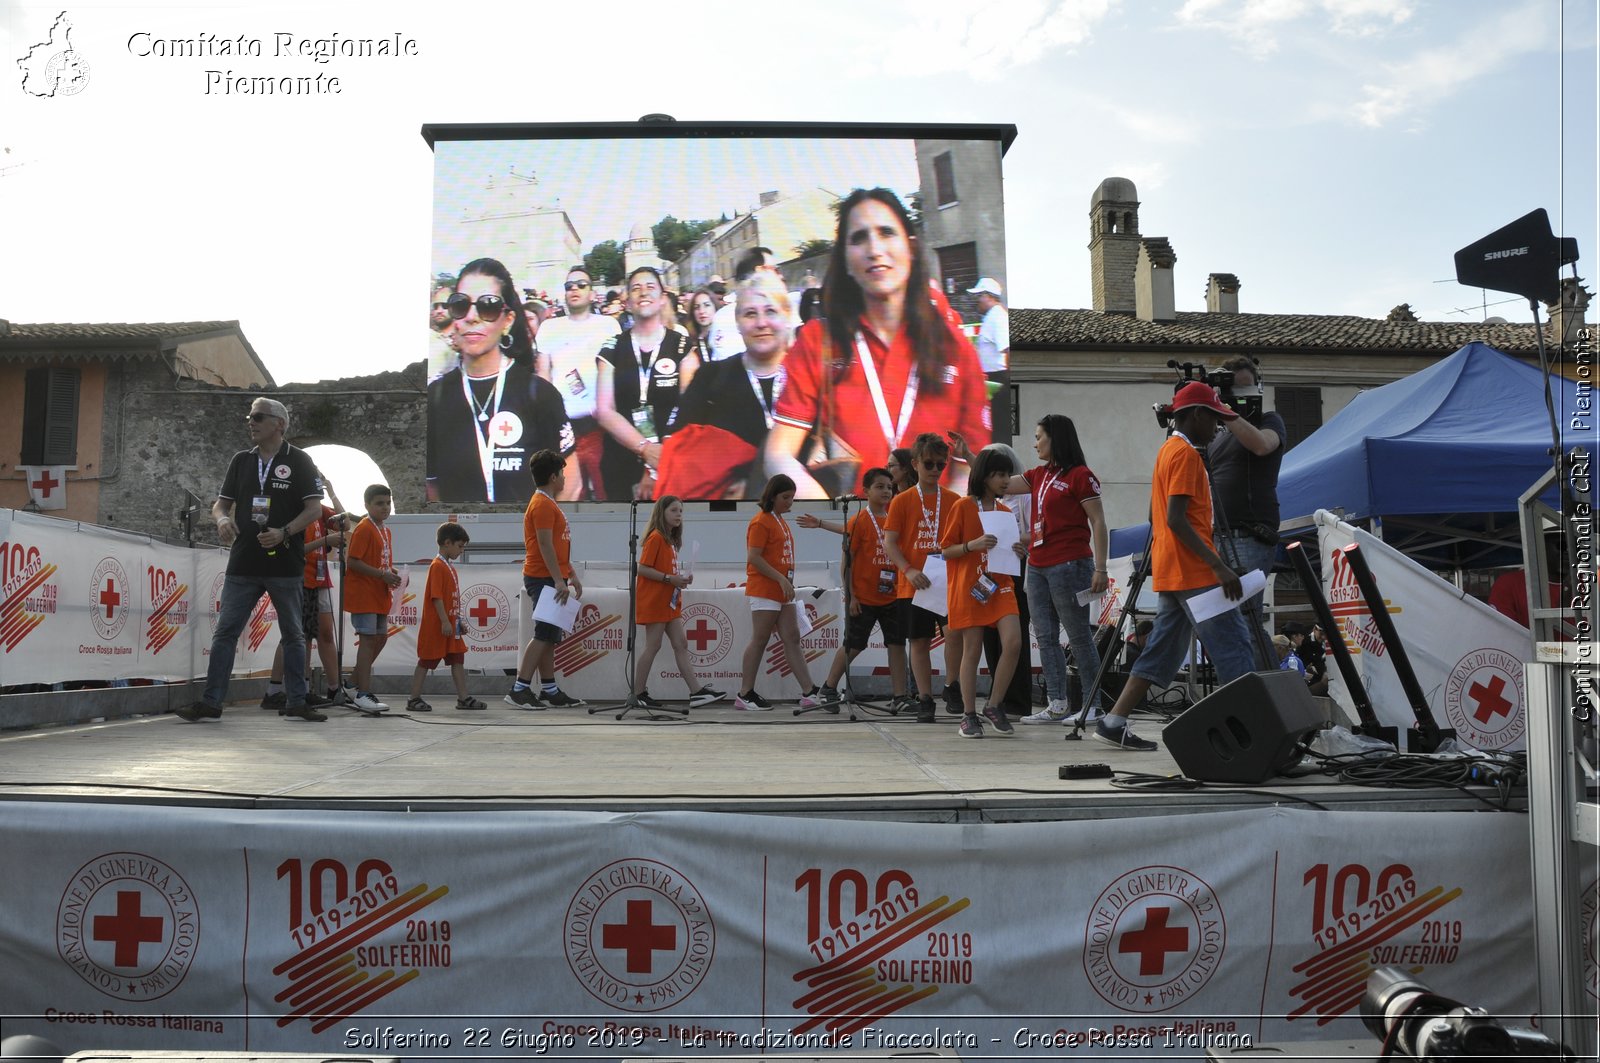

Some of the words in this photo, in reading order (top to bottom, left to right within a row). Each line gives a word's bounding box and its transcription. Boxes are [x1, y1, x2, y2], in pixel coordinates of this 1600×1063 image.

[1484, 246, 1529, 260] SHURE
[272, 482, 290, 490] STAFF
[3, 557, 42, 599] 1919-2019
[148, 565, 176, 601] 100
[42, 583, 57, 598] 2019
[1330, 586, 1359, 602] 1919-20
[25, 597, 57, 613] SOLFERINO
[401, 607, 417, 616] 2019
[604, 629, 623, 639] 2019
[689, 606, 720, 619] GINEVRA
[719, 626, 731, 654] AGOSTO
[821, 628, 839, 638] 2019
[1345, 617, 1386, 657] SOLFERINO
[79, 645, 96, 654] Croce
[96, 645, 113, 654] Rossa
[471, 645, 492, 653] Rossa
[583, 639, 623, 650] SOLFERINO
[800, 639, 839, 649] SOLFERINO
[1449, 658, 1476, 734] CONVENZIONE
[1476, 653, 1486, 666] DI
[80, 869, 100, 892] DI
[99, 858, 170, 891] GINEVRA
[609, 866, 683, 900] GINEVRA
[168, 885, 188, 907] 22
[277, 858, 393, 932] 100
[588, 878, 610, 901] DI
[1107, 887, 1128, 910] DI
[1127, 873, 1200, 904] GINEVRA
[1303, 863, 1413, 935] 100
[291, 876, 398, 950] 1919-2019
[681, 897, 700, 915] 22
[795, 868, 914, 945] 100
[1195, 897, 1213, 916] 22
[1314, 879, 1416, 950] 1919-2019
[406, 920, 451, 942] 2019
[810, 887, 919, 963] 1919-2019
[1421, 920, 1462, 944] 2019
[63, 887, 121, 993] CONVENZIONE
[165, 910, 194, 978] AGOSTO
[570, 897, 628, 1003] CONVENZIONE
[679, 919, 709, 985] AGOSTO
[927, 932, 972, 957] 2019
[1189, 919, 1220, 983] AGOSTO
[357, 944, 451, 968] SOLFERINO
[1089, 906, 1138, 1005] CONVENZIONE
[1370, 945, 1459, 964] SOLFERINO
[141, 973, 170, 995] 1864
[877, 960, 973, 984] SOLFERINO
[650, 979, 682, 1005] 1864
[1159, 978, 1190, 1004] 1864
[45, 1007, 97, 1024] Croce
[103, 1010, 156, 1028] Rossa
[162, 1013, 224, 1033] Italiana
